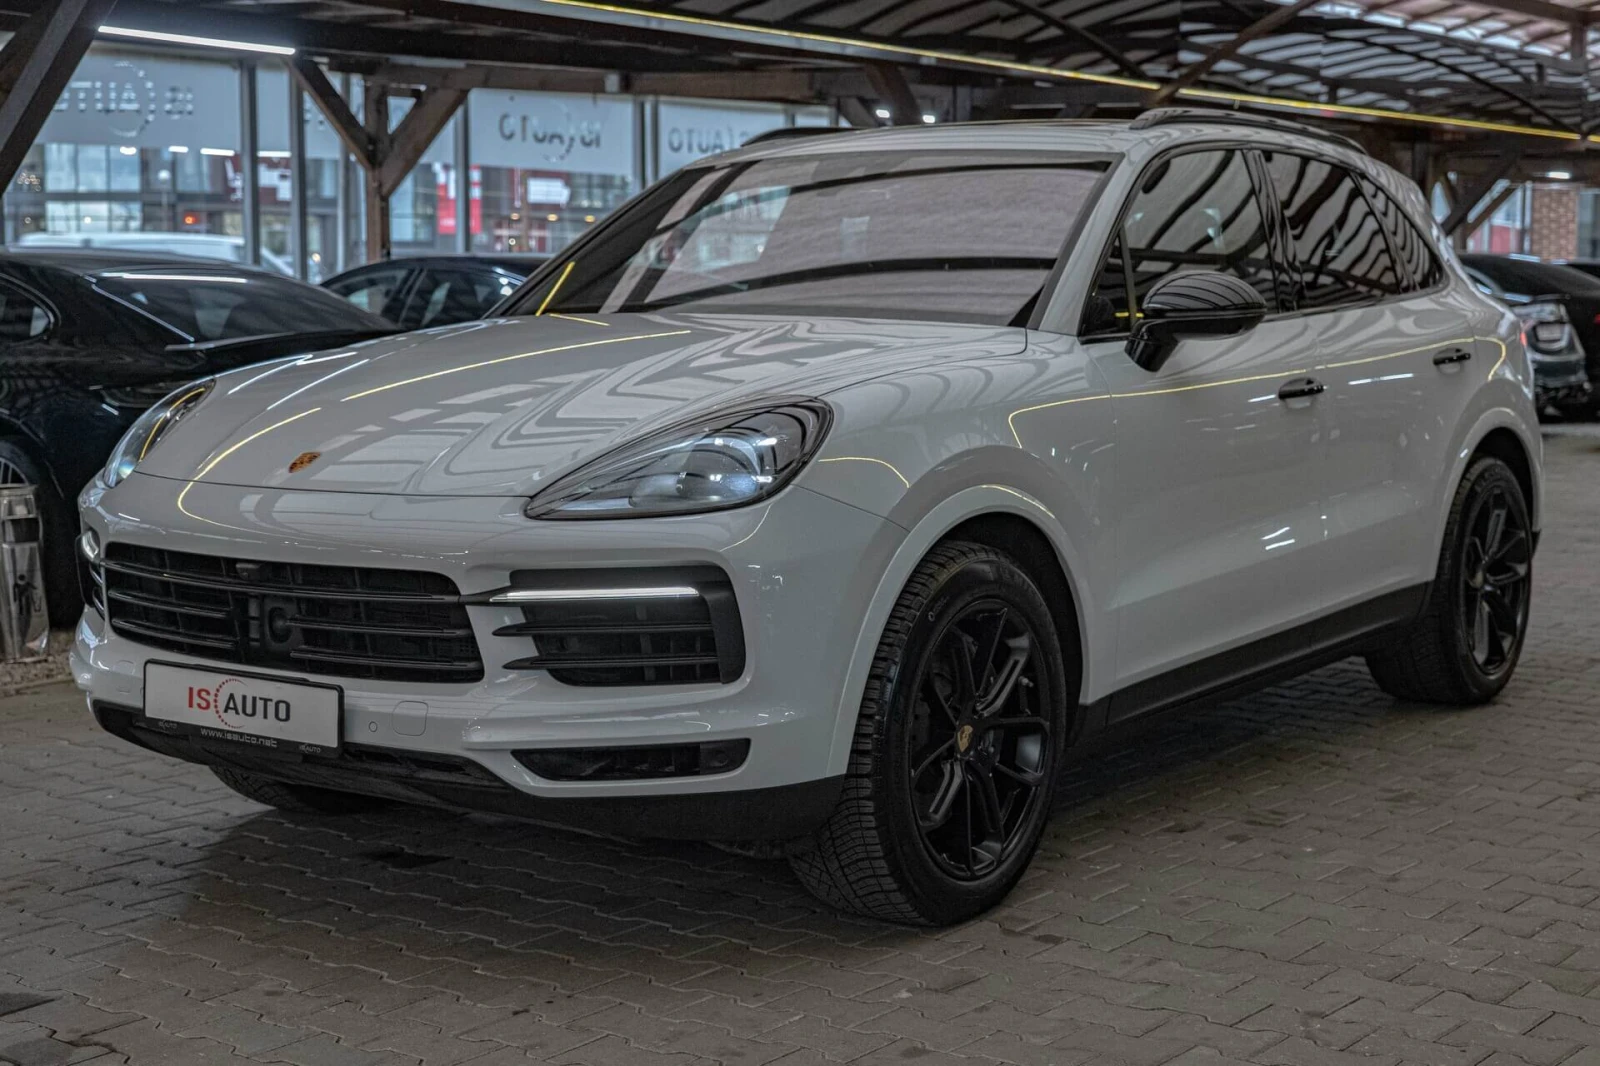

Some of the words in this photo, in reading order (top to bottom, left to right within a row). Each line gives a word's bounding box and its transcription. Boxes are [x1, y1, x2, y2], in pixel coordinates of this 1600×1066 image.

[187, 686, 211, 710] IS
[223, 692, 291, 722] AUTO
[200, 728, 278, 748] www.isauto.net
